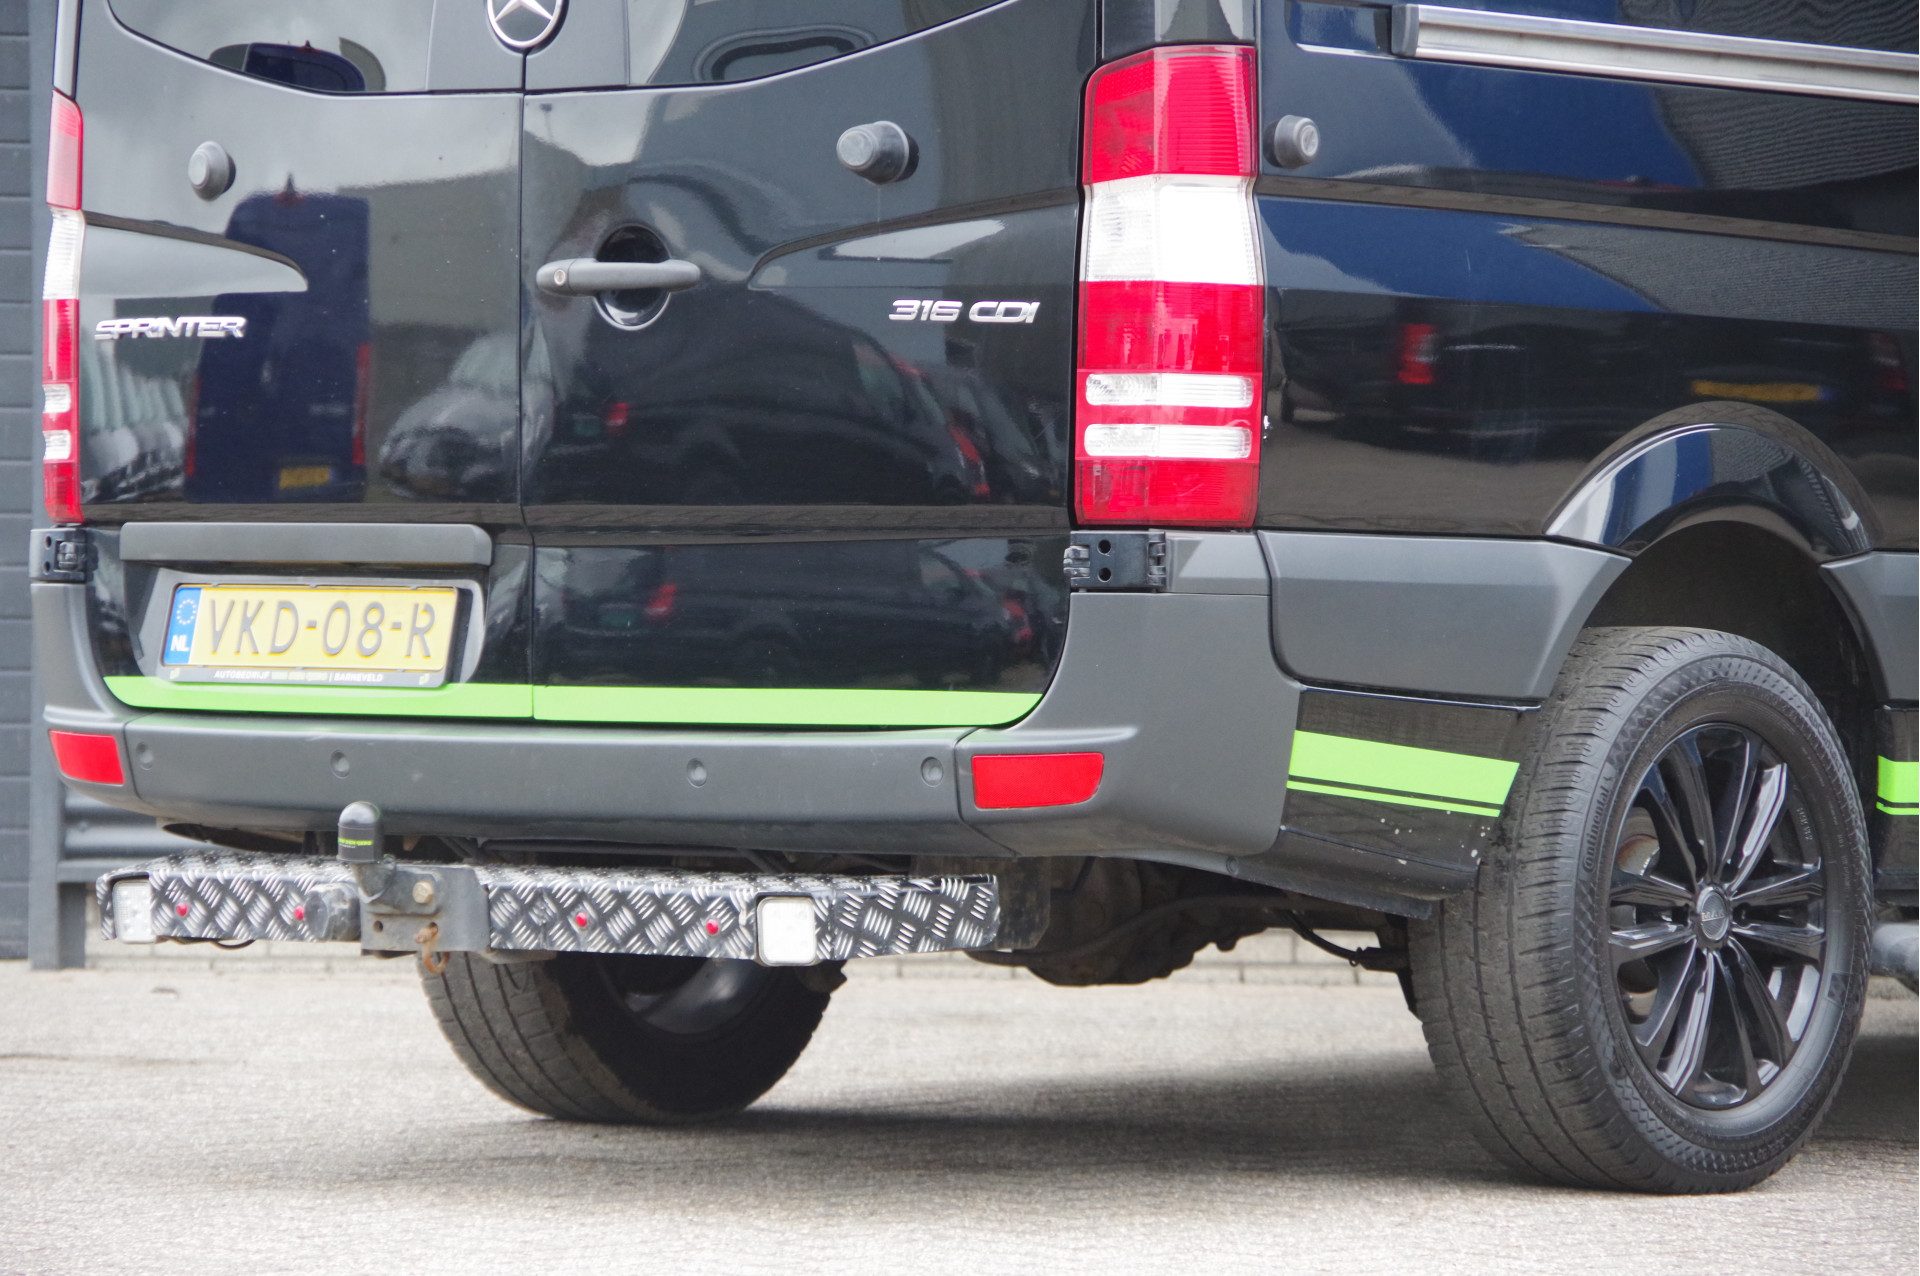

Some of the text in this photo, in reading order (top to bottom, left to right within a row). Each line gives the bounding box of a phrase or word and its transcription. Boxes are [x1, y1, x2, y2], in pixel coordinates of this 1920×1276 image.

[888, 299, 1041, 324] 316 CDI
[94, 316, 247, 340] SPRINTER
[209, 599, 436, 658] VKD-08-R
[170, 634, 191, 653] NL
